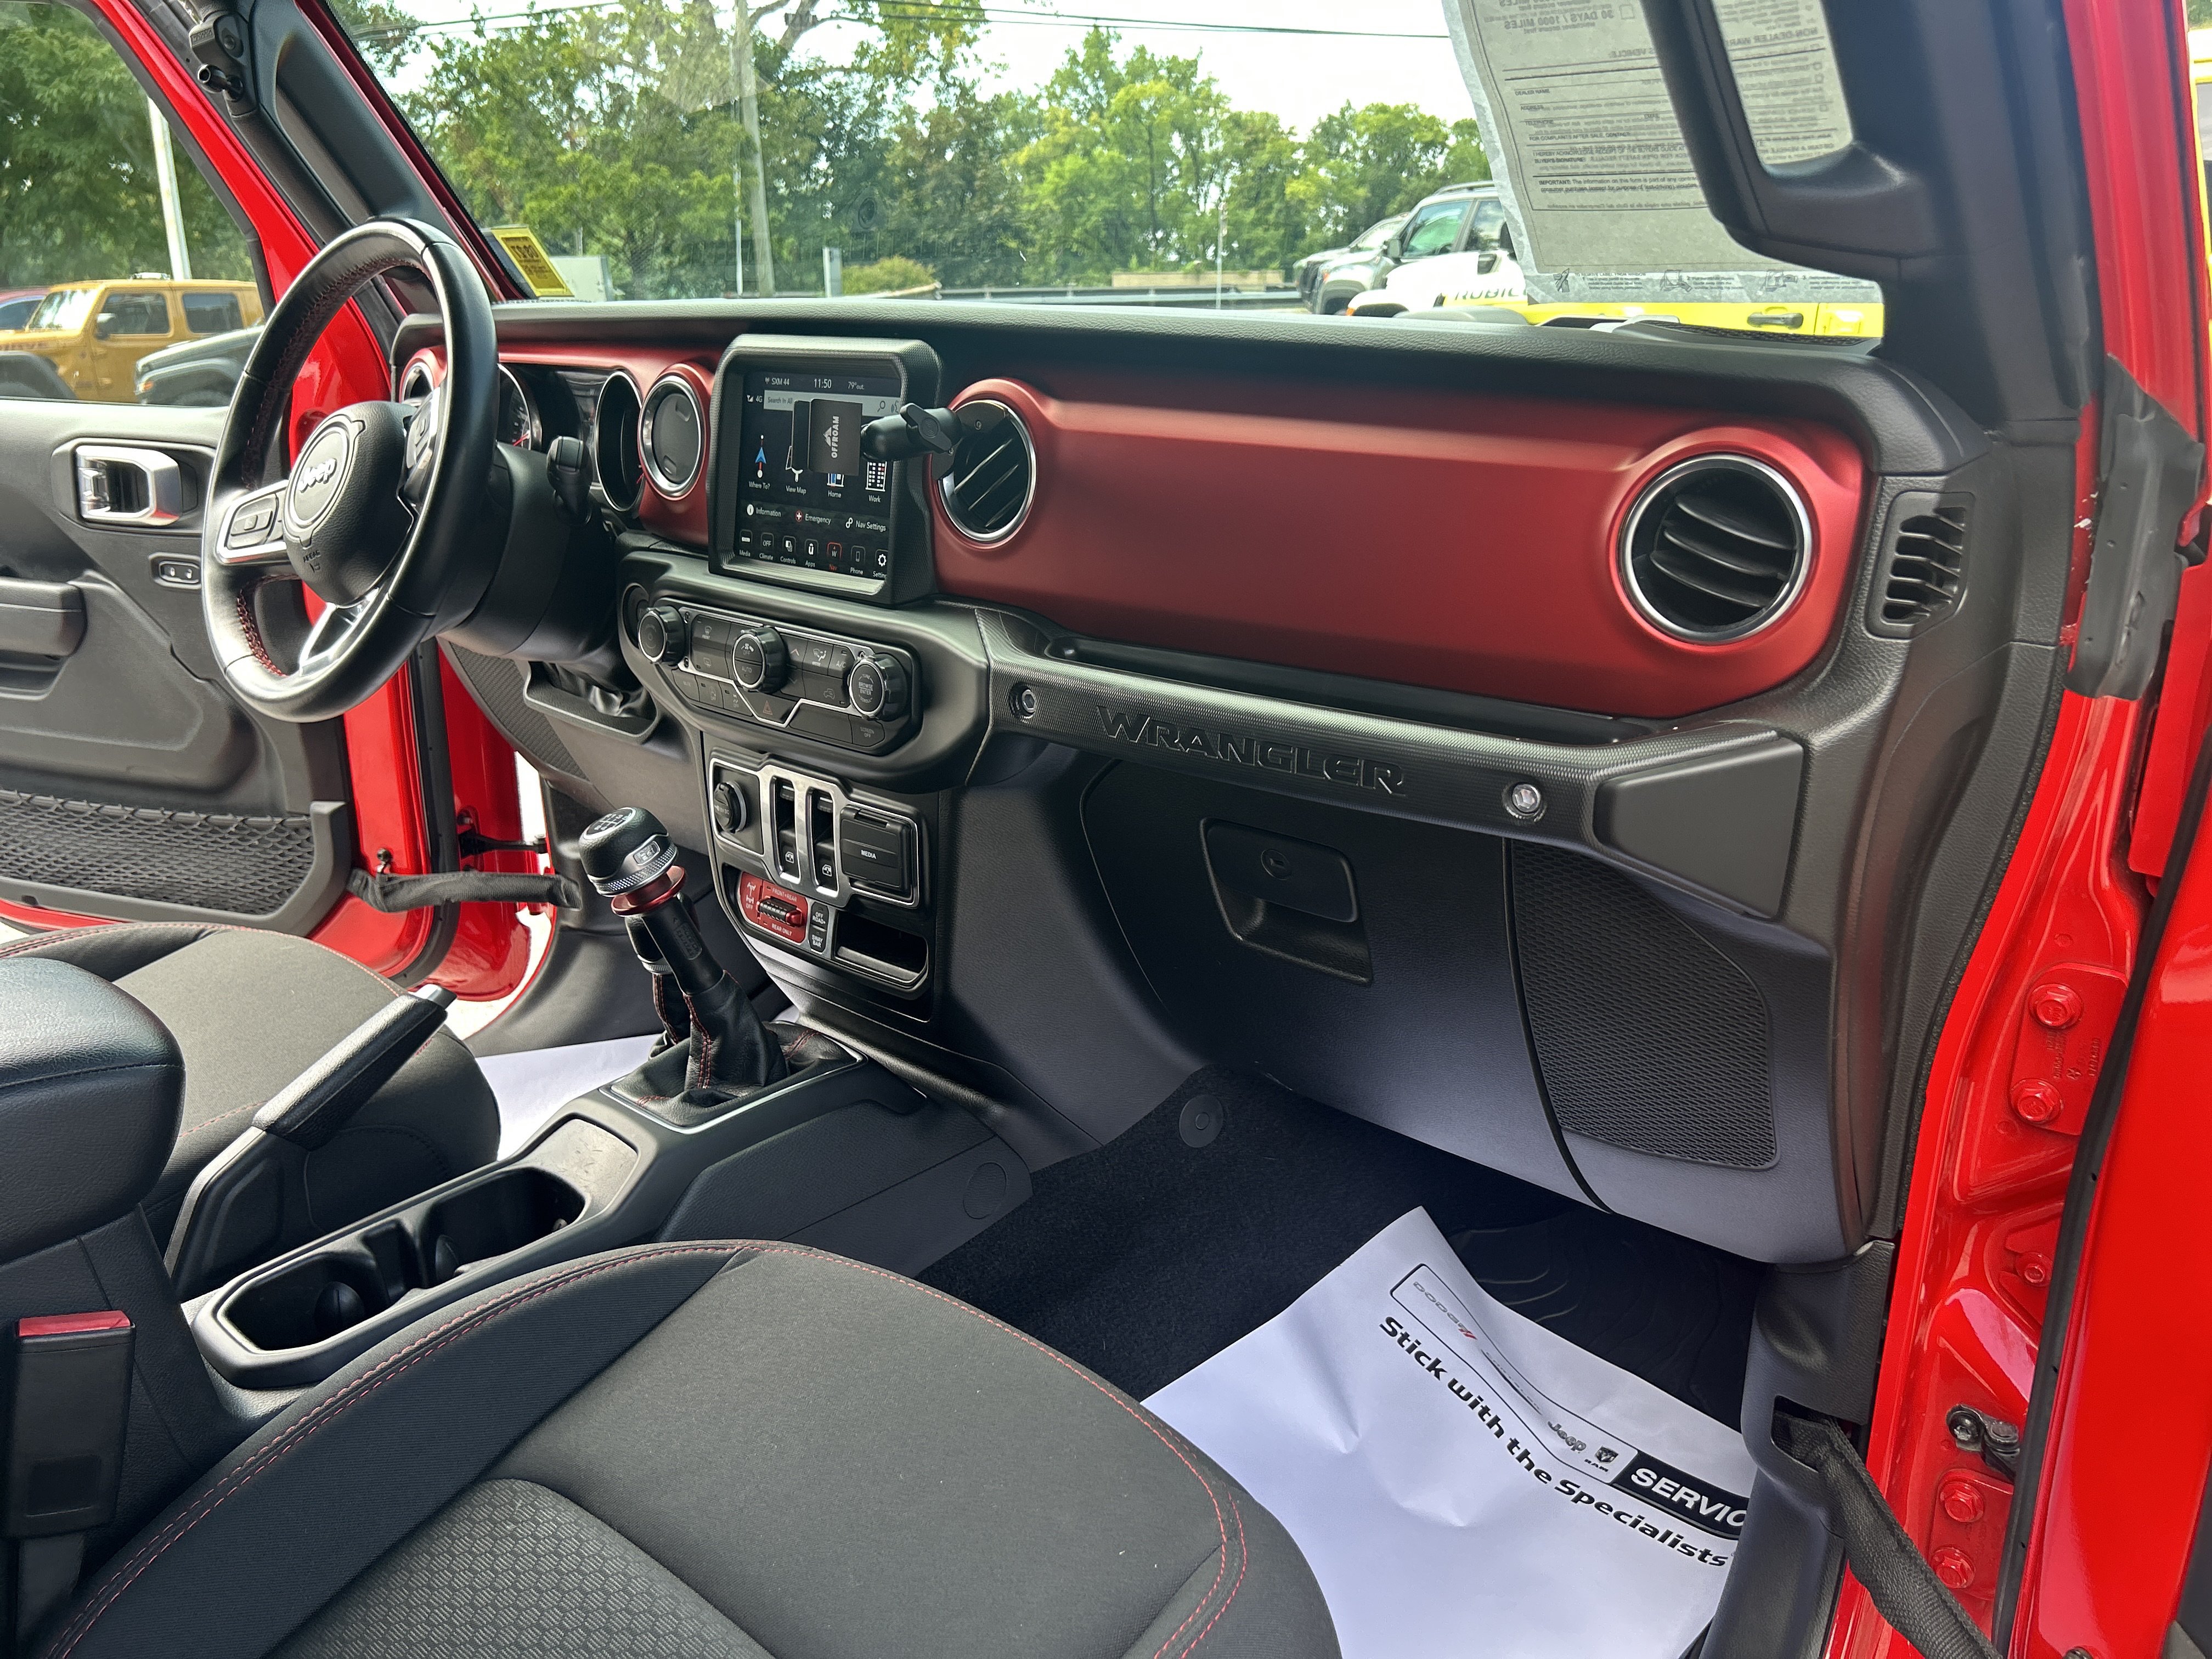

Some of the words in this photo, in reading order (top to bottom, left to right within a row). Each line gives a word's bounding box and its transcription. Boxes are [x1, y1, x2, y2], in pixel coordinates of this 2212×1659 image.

[1454, 287, 1527, 301] RUBIC
[814, 378, 832, 389] 11:50
[755, 395, 763, 403] 4G
[831, 415, 839, 459] OFFROAM
[298, 458, 337, 493] Jeep
[797, 487, 806, 495] Map
[827, 489, 842, 498] Home
[868, 495, 881, 503] Work
[755, 506, 782, 517] Information
[805, 514, 831, 526] Emergency
[855, 520, 865, 529] Nav
[866, 522, 887, 532] Settings
[850, 567, 864, 575] Phone
[836, 660, 847, 668] A/C
[1097, 705, 1406, 797] WRANGLER
[861, 849, 876, 860] MEDIA
[771, 923, 782, 932] REAR
[782, 927, 793, 936] ONLY
[812, 940, 822, 948] BAR
[1378, 1316, 1448, 1381] Stick
[1447, 1378, 1506, 1440] with
[1506, 1436, 1553, 1485] the
[1554, 1479, 1728, 1567] Specialists
[1547, 1421, 1587, 1453] Jeep
[1584, 1458, 1610, 1473] RAM
[1630, 1468, 1747, 1527] SERVIC
